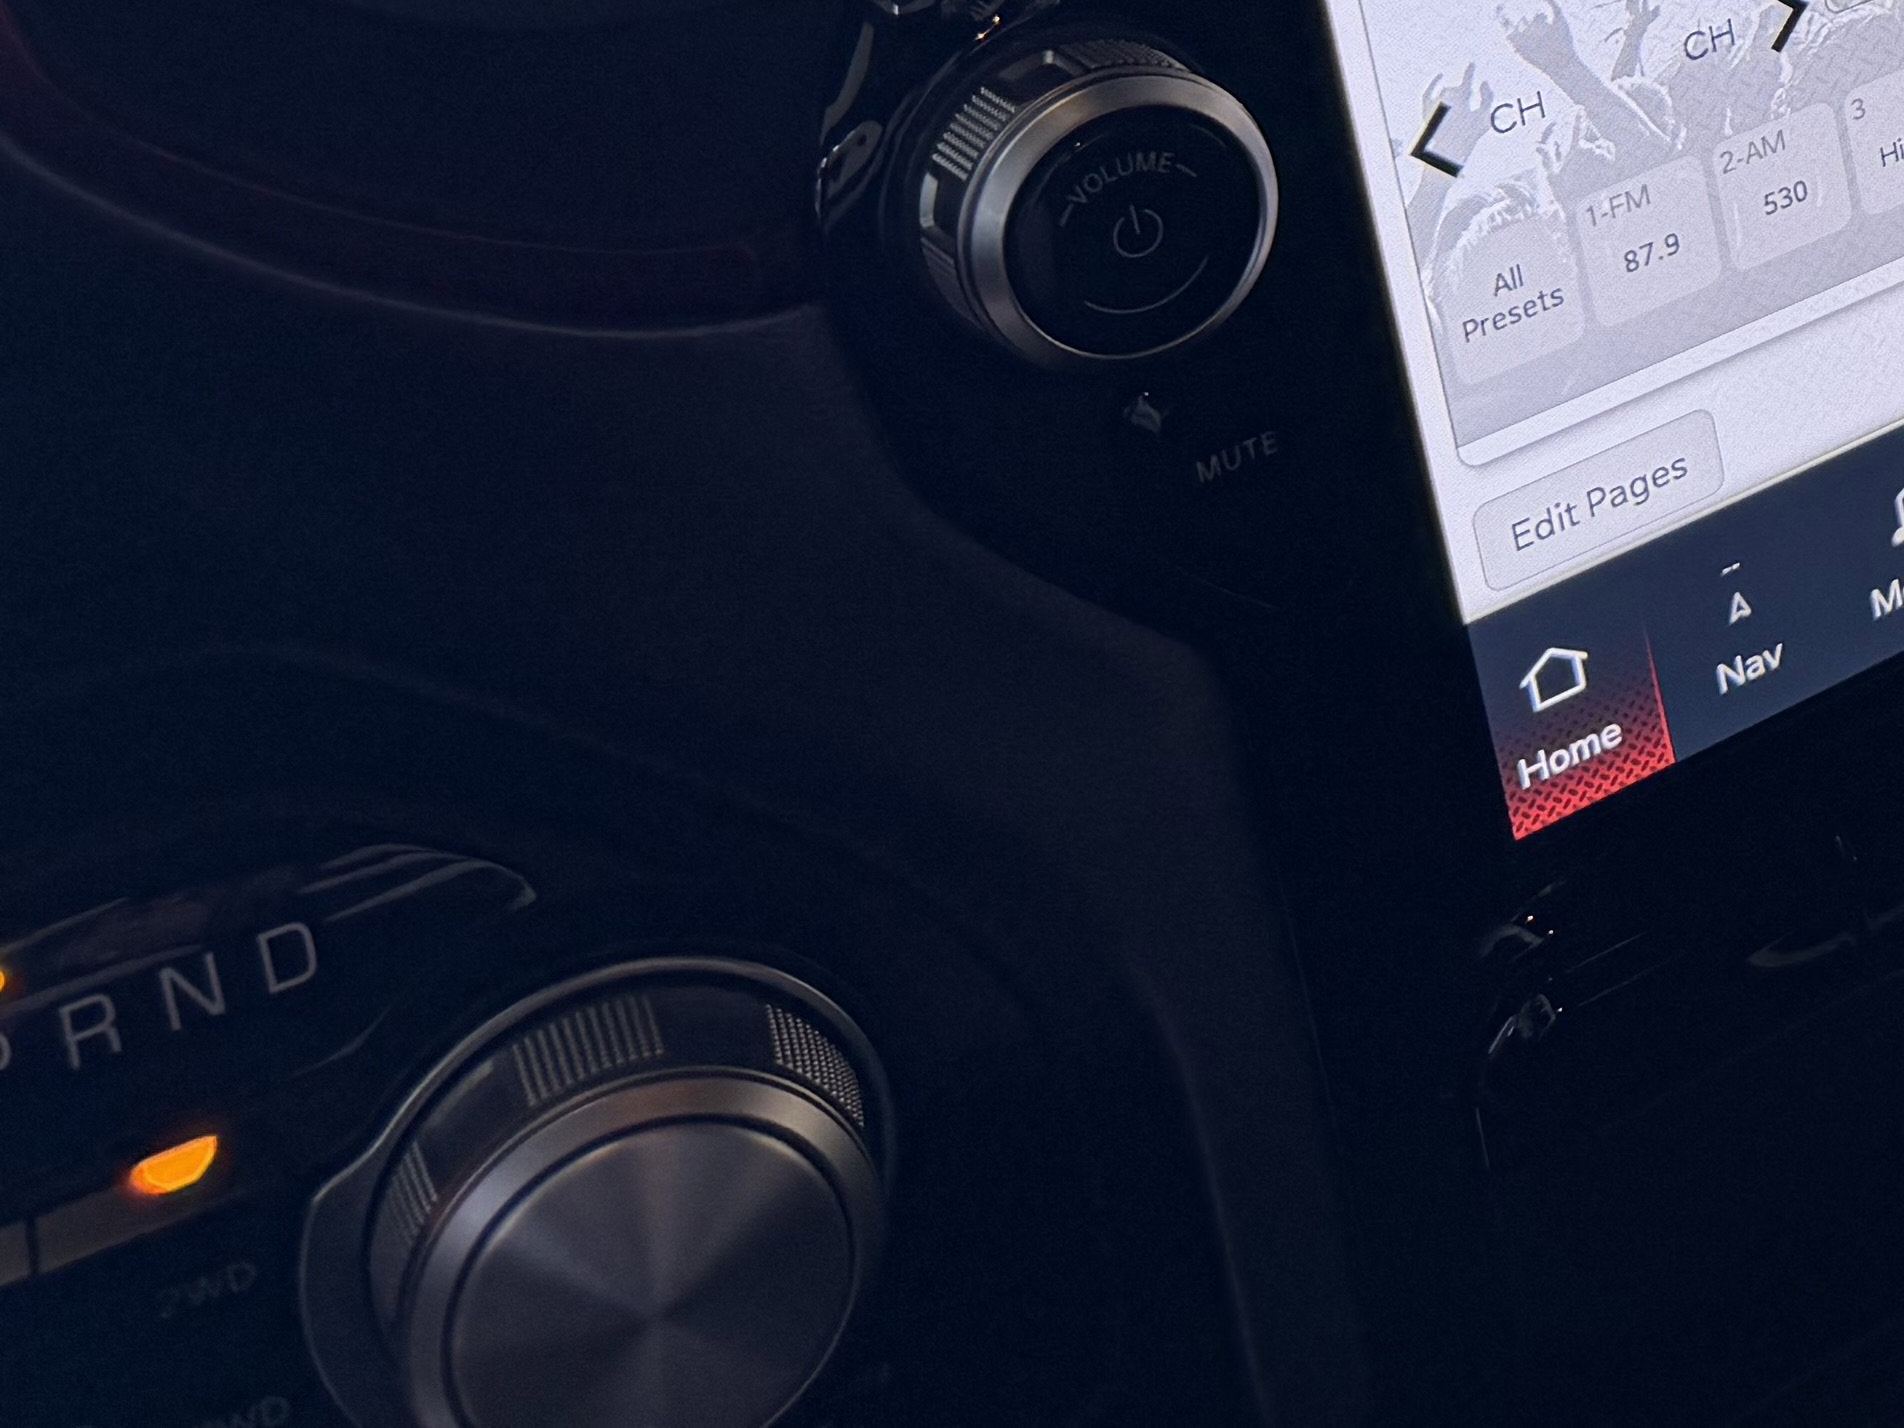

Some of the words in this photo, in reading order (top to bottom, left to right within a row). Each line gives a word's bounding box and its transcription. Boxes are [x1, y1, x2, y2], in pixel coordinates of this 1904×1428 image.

[1682, 19, 1736, 62] CH
[1489, 91, 1546, 135] CH
[1851, 98, 1867, 121] 3
[1719, 128, 1788, 175] 2-AM
[1068, 150, 1175, 206] VOLUME
[1762, 180, 1809, 217] 530
[1585, 184, 1652, 228] 1-FM
[1622, 232, 1682, 274] 87.9
[1492, 264, 1525, 296] All
[1461, 284, 1565, 344] Presets
[1196, 429, 1279, 484] MUTE
[1510, 503, 1581, 552] Edit
[1586, 456, 1689, 519] Pages
[1715, 643, 1784, 696] Nav
[1517, 722, 1624, 791] Home
[58, 994, 122, 1070] R
[159, 951, 226, 1031] N
[257, 922, 318, 994] D
